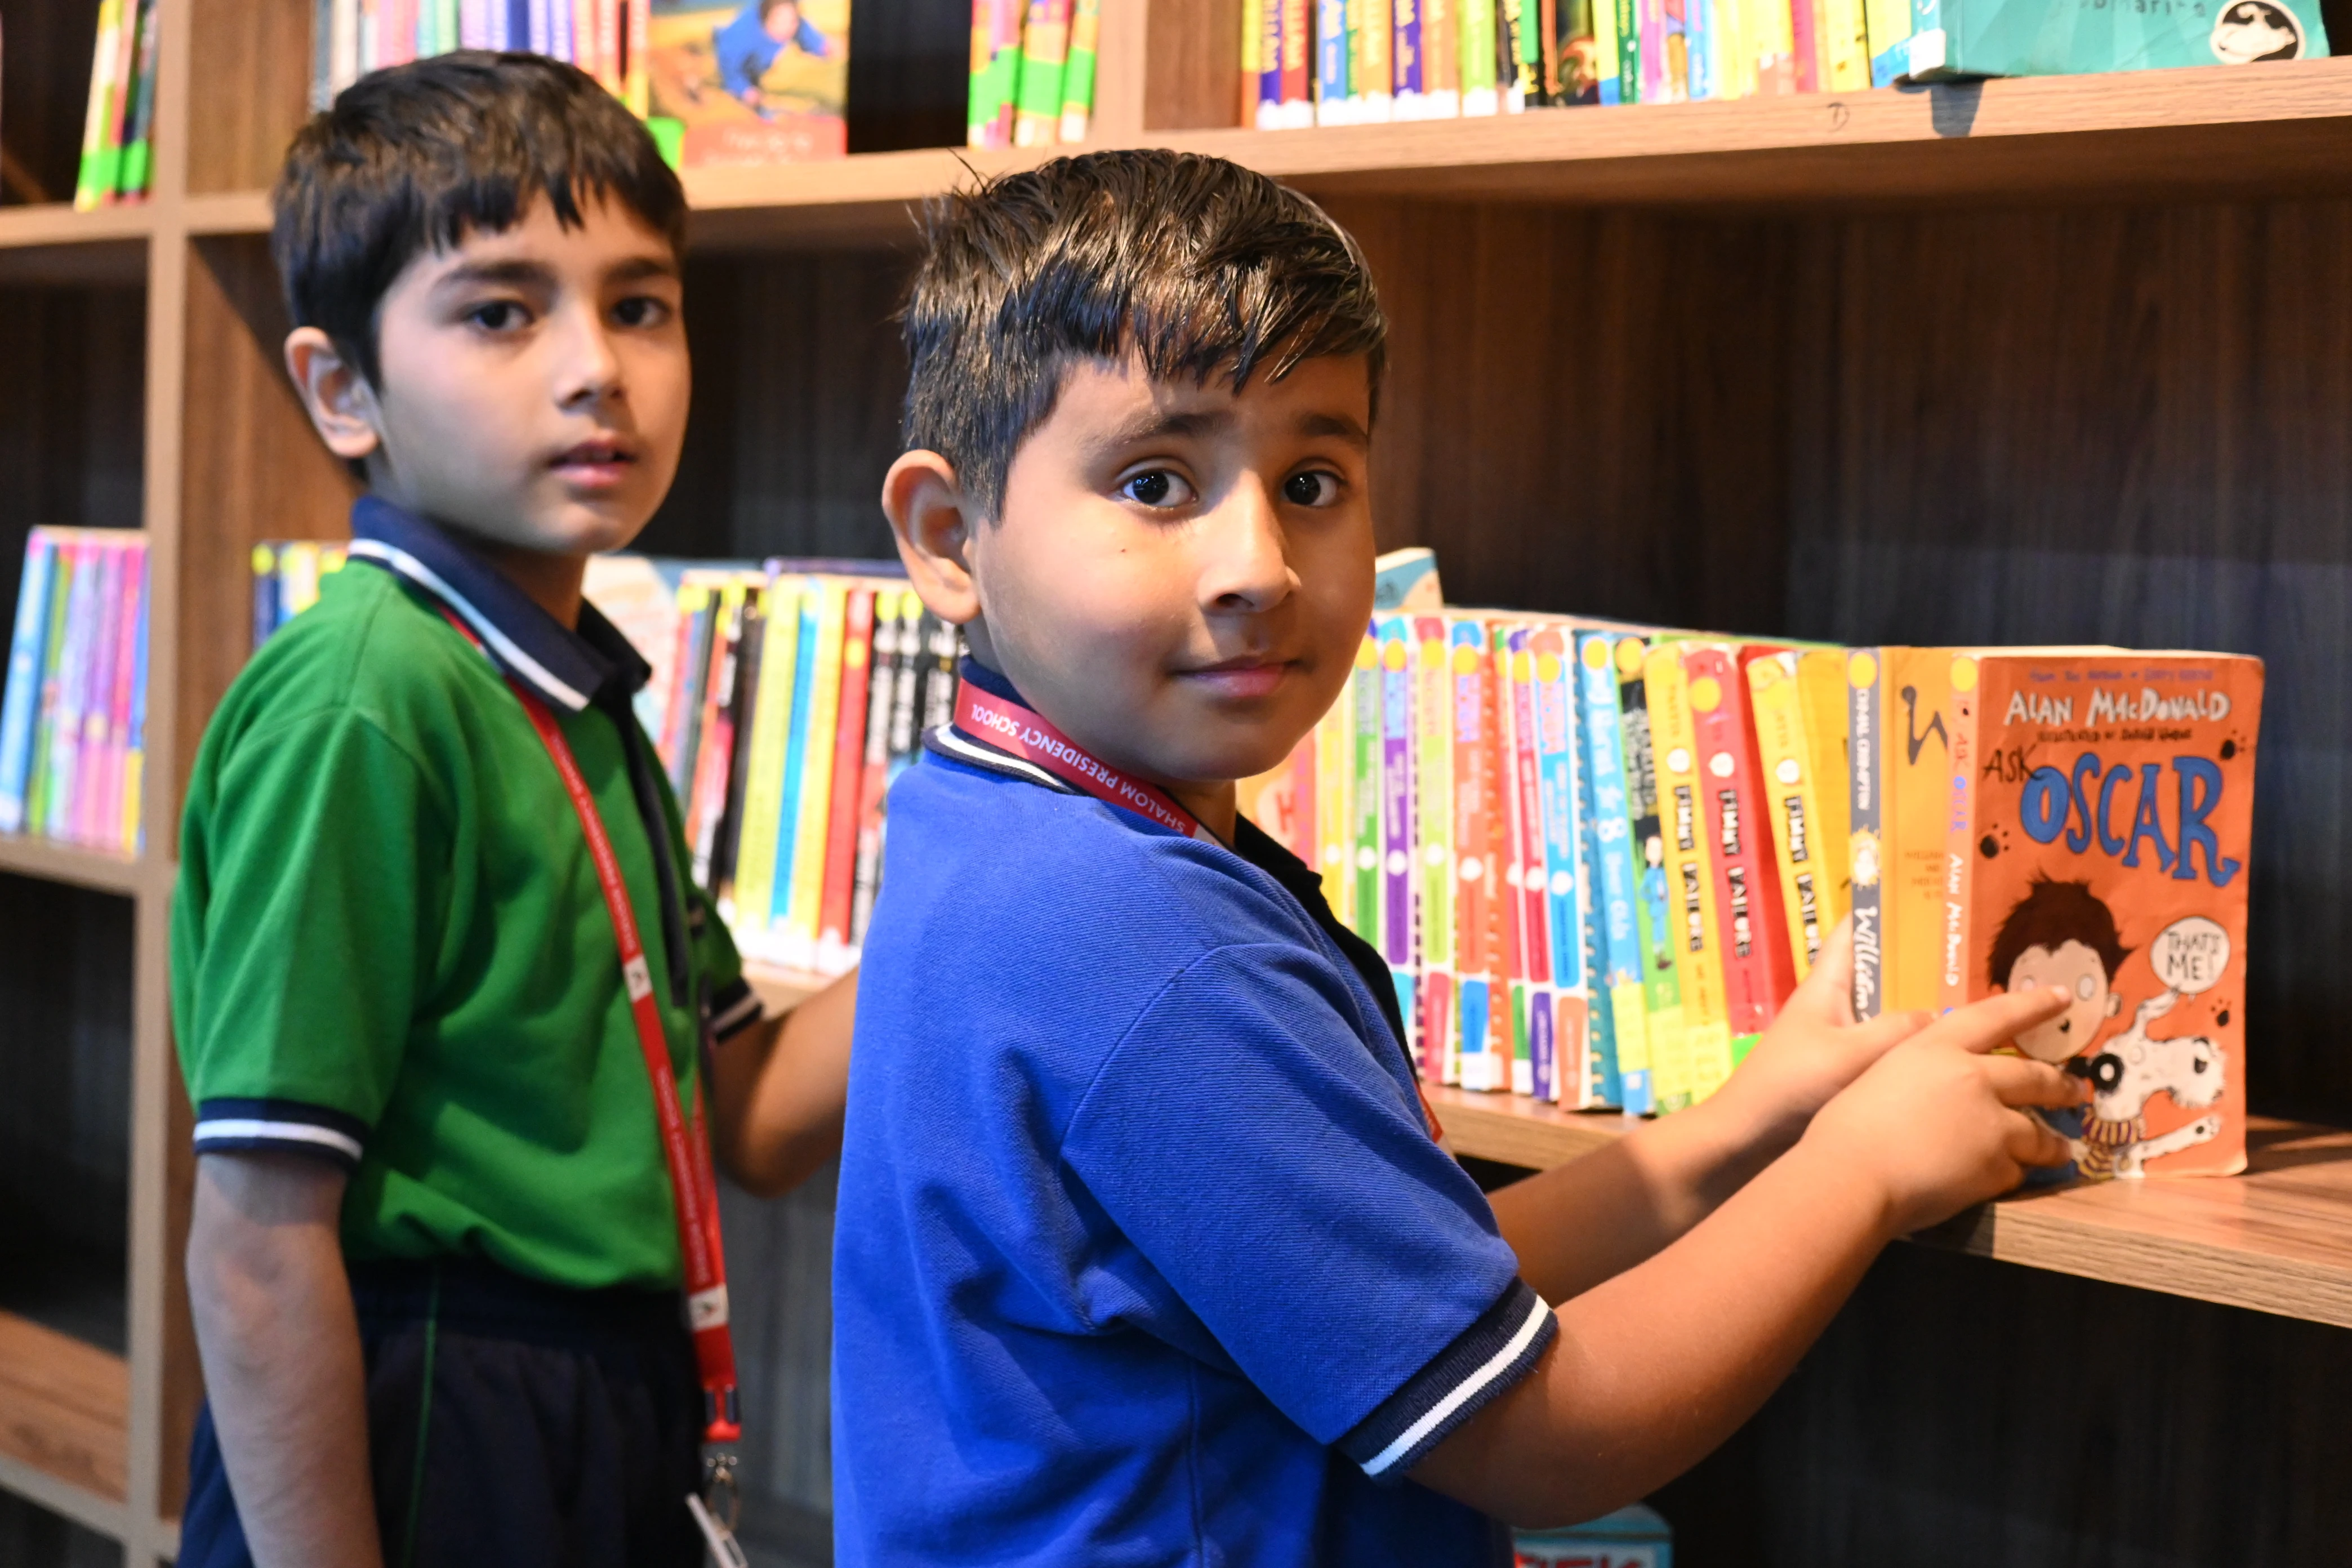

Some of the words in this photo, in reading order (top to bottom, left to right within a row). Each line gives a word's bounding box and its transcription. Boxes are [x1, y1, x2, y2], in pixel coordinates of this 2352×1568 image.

[970, 703, 1021, 737] SCHOOL
[2004, 689, 2074, 727] ALAN
[1019, 726, 1120, 789] PRESIDENCY
[1981, 743, 2047, 783] ASK
[1122, 781, 1186, 834] SHALOM
[1597, 817, 1628, 844] 8
[1718, 789, 1742, 857] TIMMY
[2020, 752, 2241, 887] OSCAR
